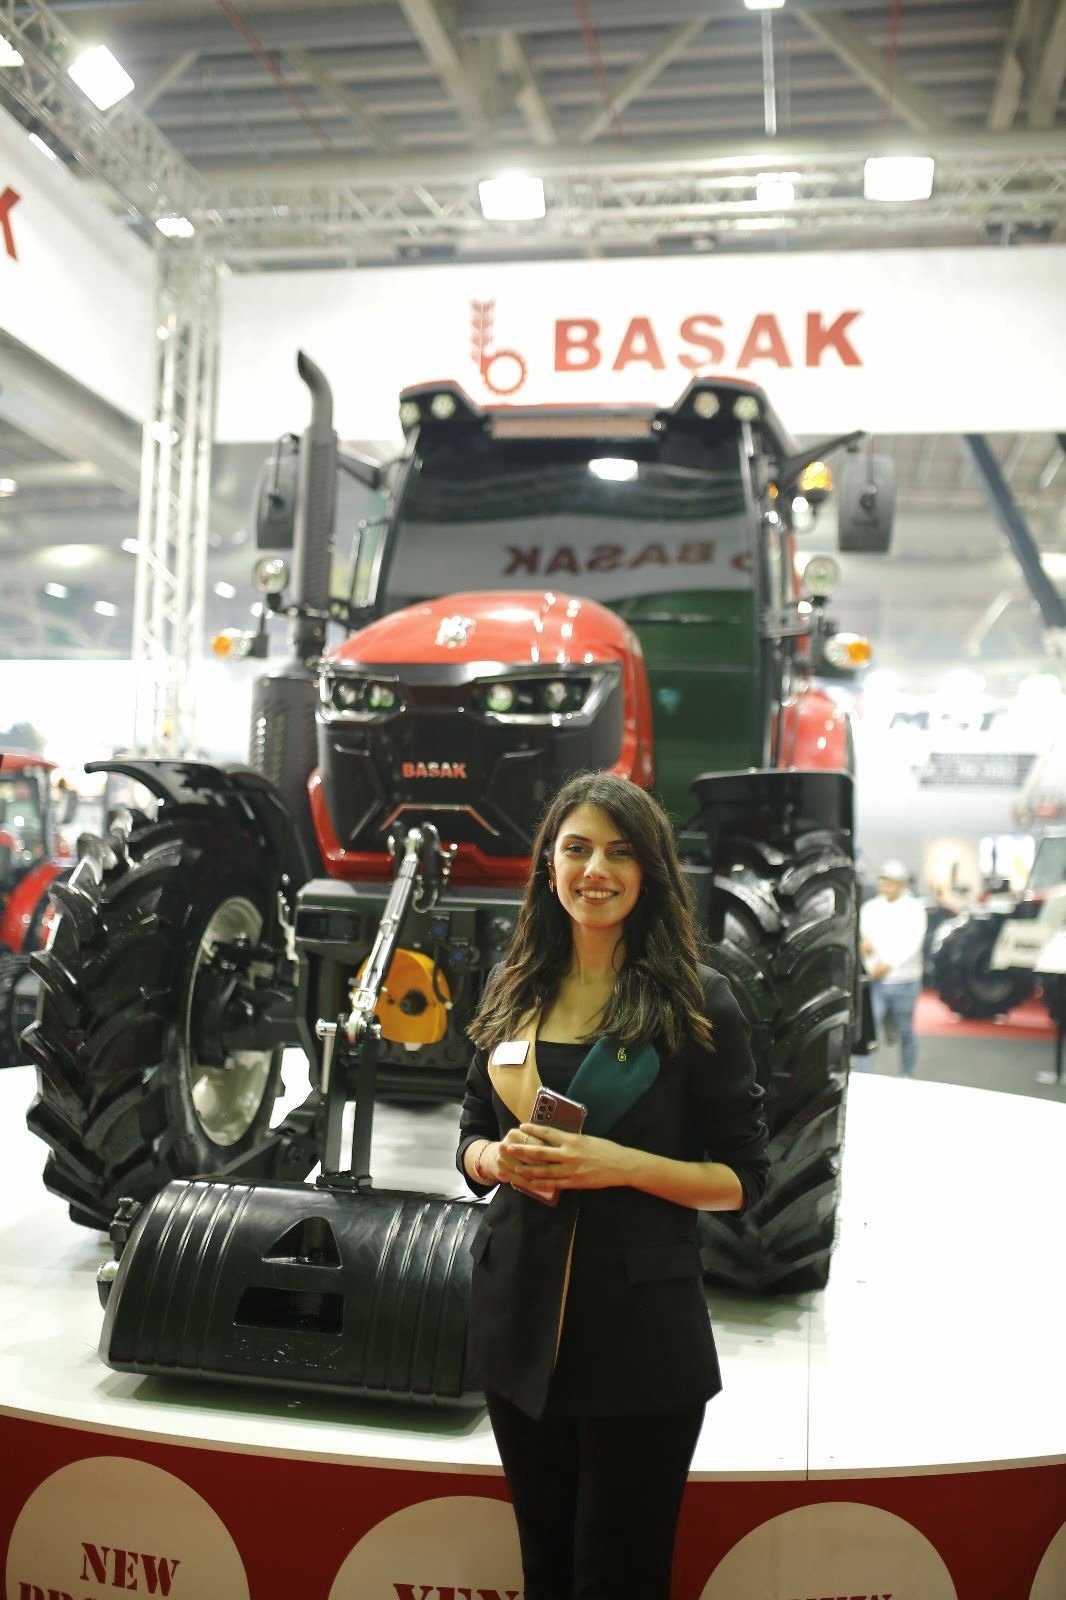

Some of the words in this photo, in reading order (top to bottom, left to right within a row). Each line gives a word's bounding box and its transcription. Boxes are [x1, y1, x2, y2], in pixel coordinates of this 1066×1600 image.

[553, 309, 865, 373] BASAK
[402, 761, 467, 778] BASAK
[80, 1542, 181, 1597] NEW
